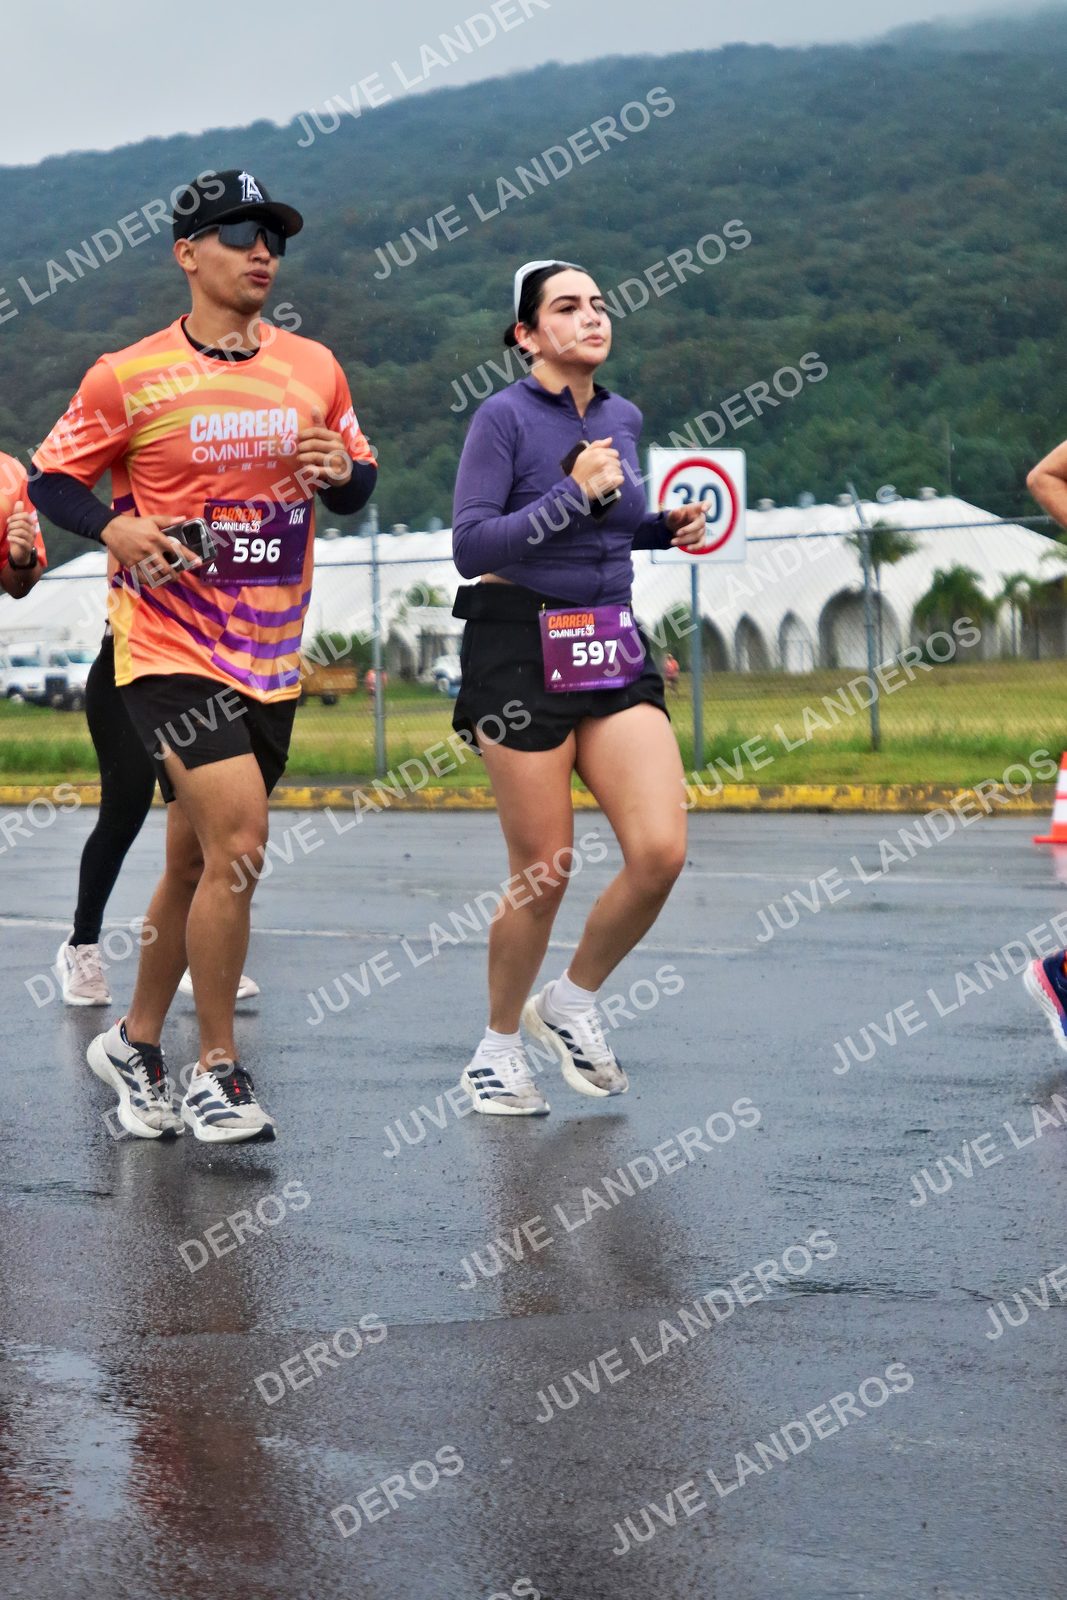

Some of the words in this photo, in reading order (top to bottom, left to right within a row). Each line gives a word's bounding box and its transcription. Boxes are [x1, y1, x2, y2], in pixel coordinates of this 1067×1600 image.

[190, 408, 298, 443] CARRERA
[192, 440, 277, 464] OMNILIFE
[211, 507, 263, 521] CARRERA
[211, 521, 250, 533] OMNILIFE
[232, 538, 281, 563] 596
[548, 613, 594, 630] CARRERA
[549, 627, 585, 639] OMNILIFE
[572, 640, 617, 666] 597
